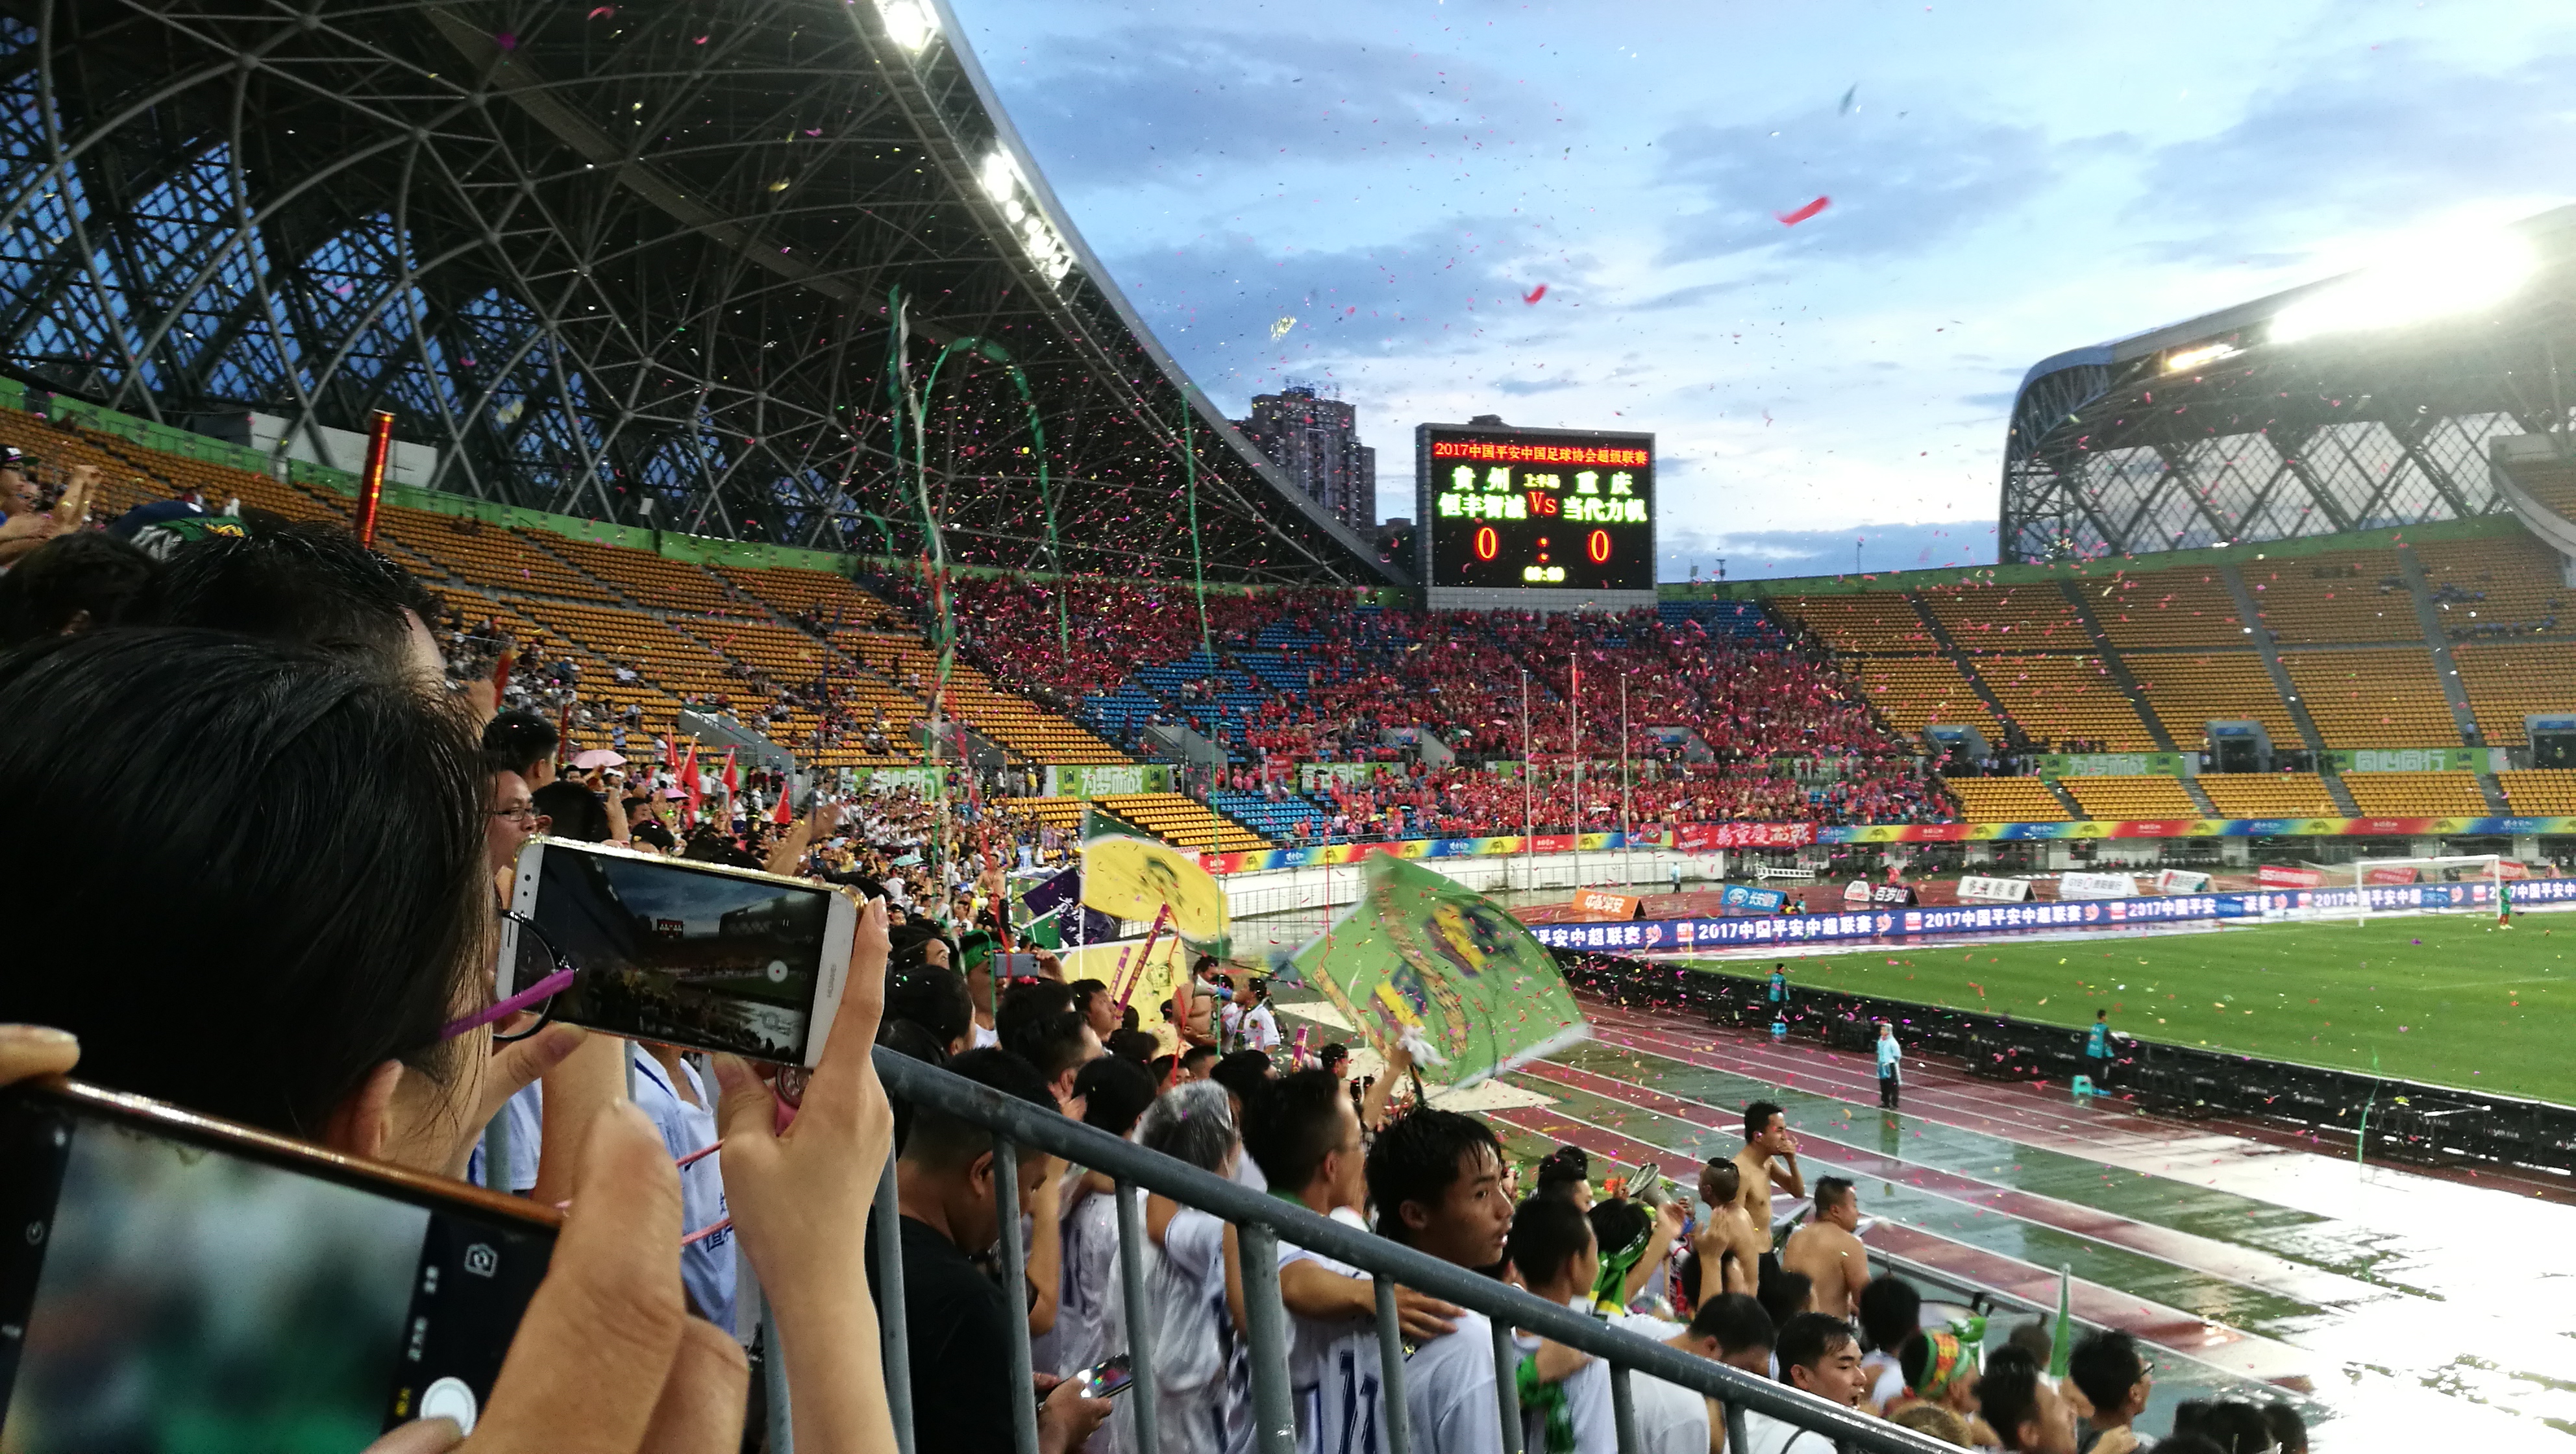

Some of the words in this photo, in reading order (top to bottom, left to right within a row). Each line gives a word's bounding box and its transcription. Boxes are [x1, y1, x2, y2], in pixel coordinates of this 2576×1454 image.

[1435, 443, 1648, 465] 2017中国平安中国足球协会超级联赛
[1524, 473, 1561, 489] 上半场
[1439, 492, 1527, 520] 恒丰智诚
[1563, 497, 1648, 522] 当代力帆
[1478, 526, 1497, 560] 0
[1591, 530, 1609, 561] 0
[1081, 767, 1143, 795] 为梦而战
[1874, 887, 1908, 902] 百岁山
[1698, 915, 1872, 940] 2017中国平安中超联赛
[1925, 905, 2081, 928] 2017中国平安中超联赛
